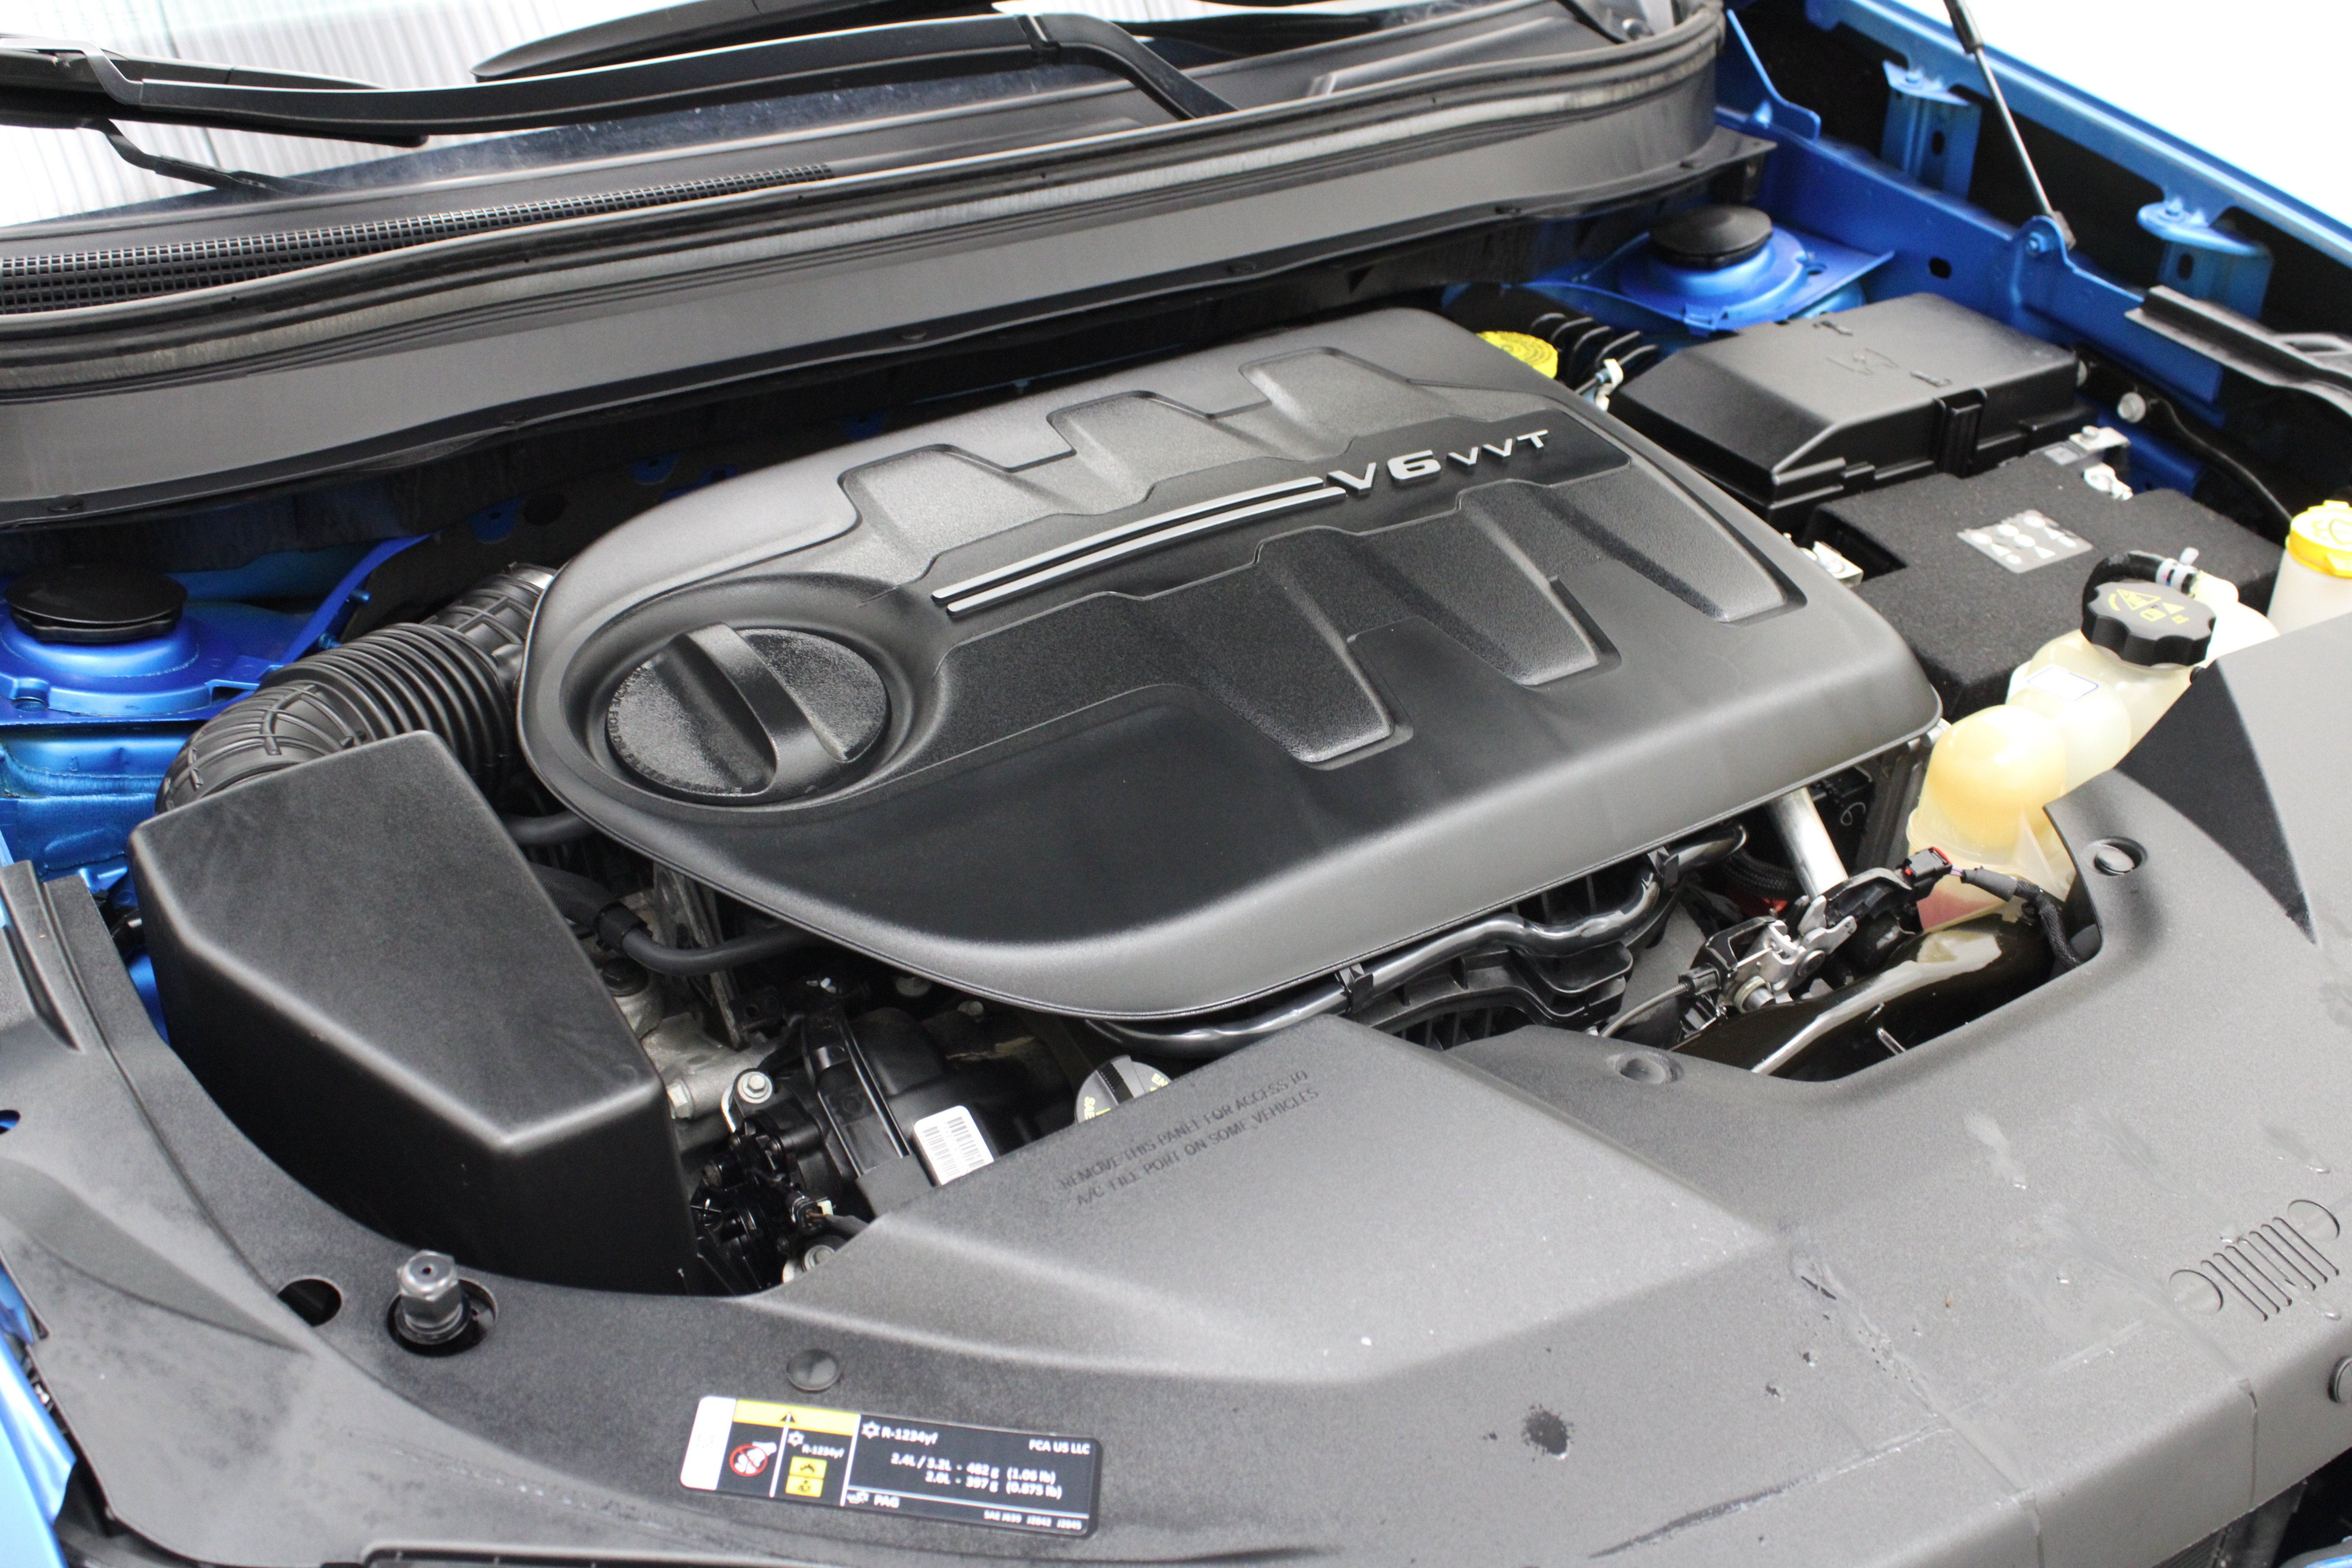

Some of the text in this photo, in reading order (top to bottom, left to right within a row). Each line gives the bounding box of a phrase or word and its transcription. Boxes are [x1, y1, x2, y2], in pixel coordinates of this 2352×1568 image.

[1327, 429, 1549, 495] V6 VVT
[1084, 1096, 1096, 1120] SAE
[1060, 1070, 1308, 1189] REMOVE THIS PANEL FOR ACCESS TO
[1077, 1089, 1319, 1205] A/C FILL PORT ON SOME VEHICLES
[881, 1425, 938, 1446] R-1234yf
[1029, 1439, 1091, 1455] FCA US LLC
[891, 1452, 916, 1467] 2.4L
[927, 1457, 952, 1471] 3.2L
[1038, 1470, 1056, 1486] lb)
[925, 1470, 951, 1485] 2.0L
[1045, 1484, 1062, 1500] lb)
[873, 1493, 900, 1508] PAG
